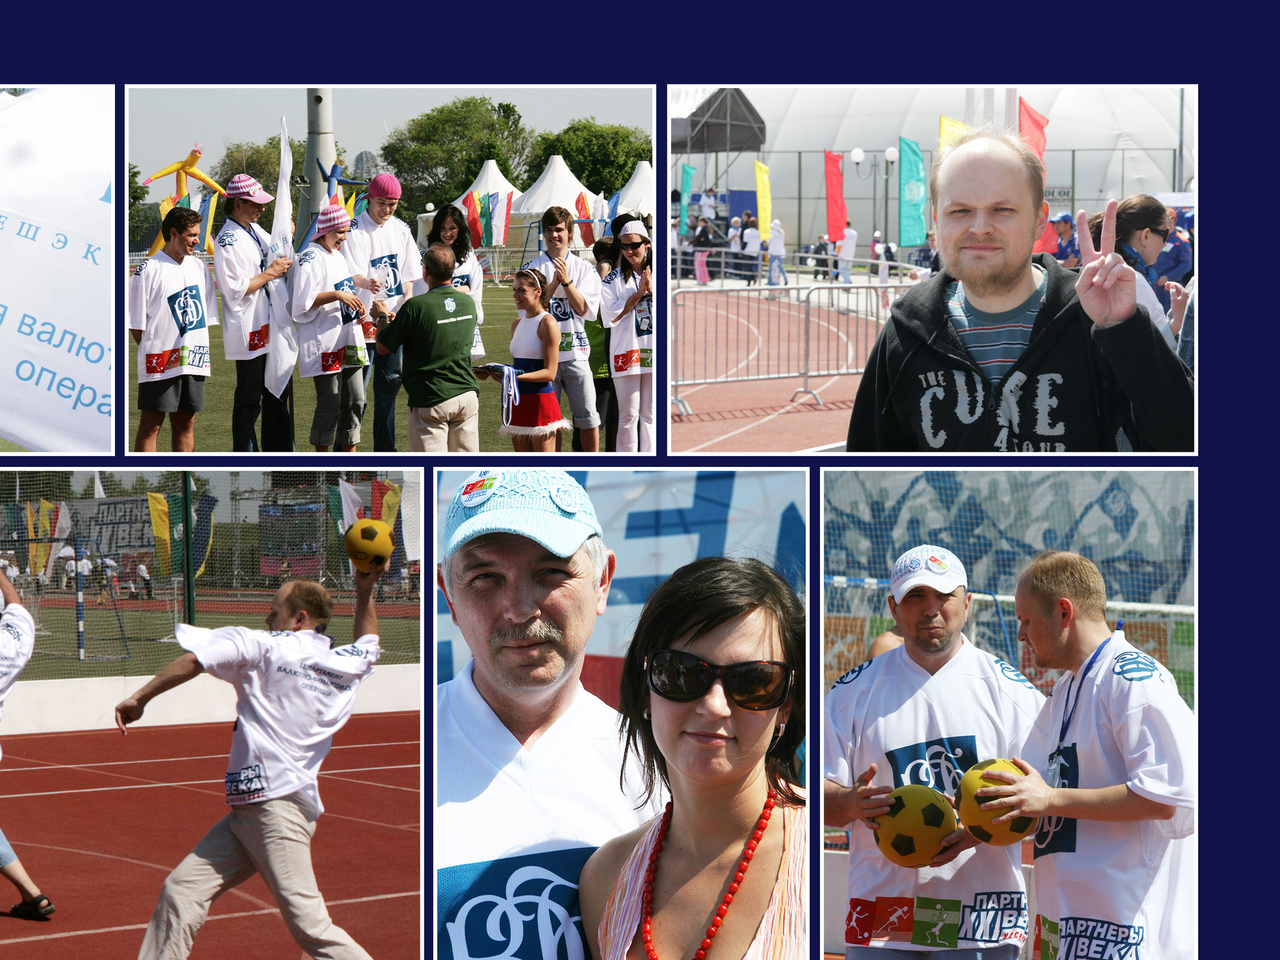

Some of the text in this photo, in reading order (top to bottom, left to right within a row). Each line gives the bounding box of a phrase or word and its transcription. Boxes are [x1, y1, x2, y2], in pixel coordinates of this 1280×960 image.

[15, 360, 112, 417] опера
[919, 371, 946, 388] THE
[920, 370, 1065, 448] CURE
[959, 906, 1000, 941] XXI
[1060, 918, 1144, 946] ПАРТНЕРЫ
